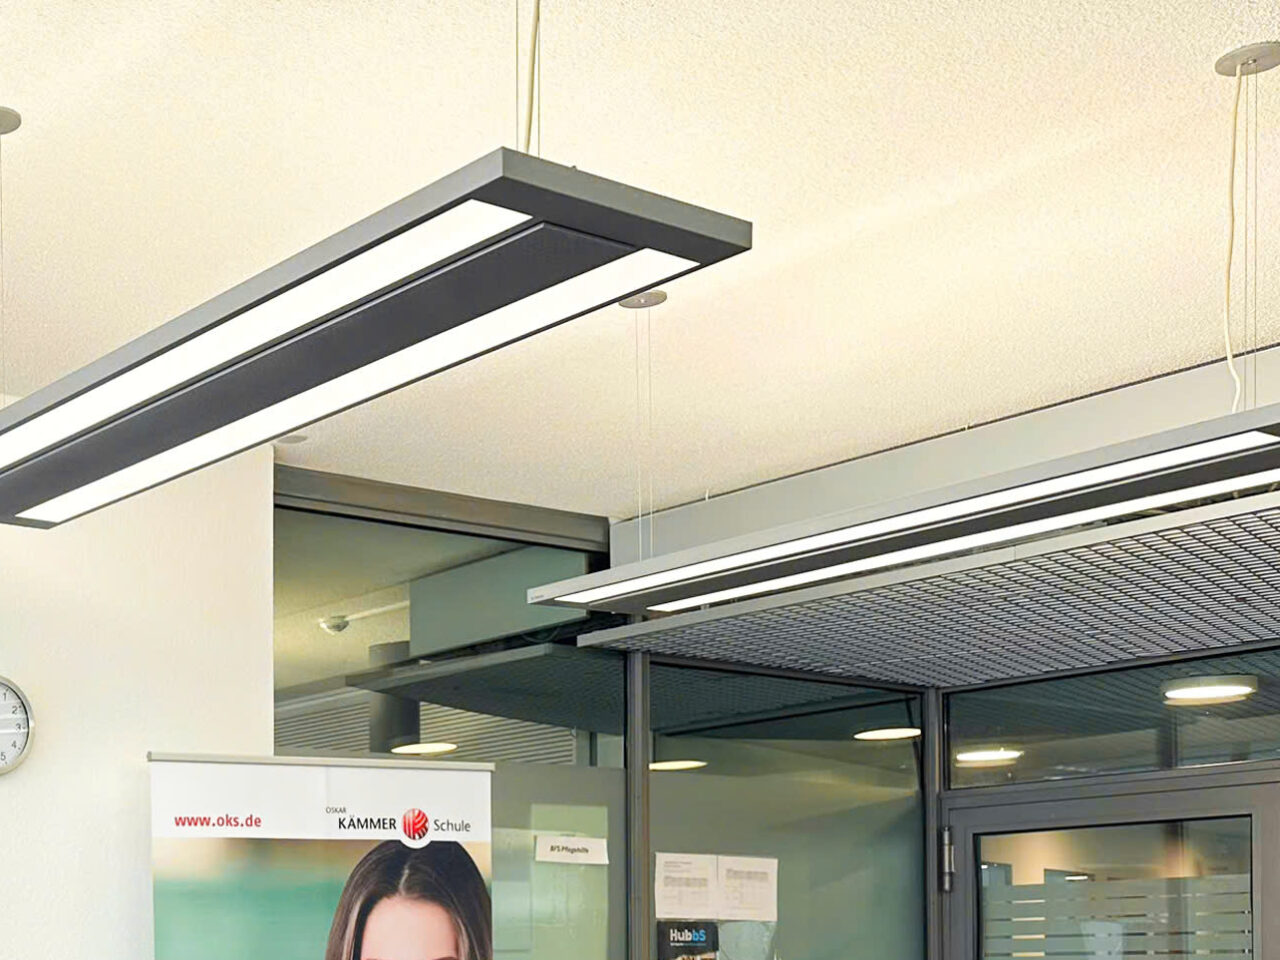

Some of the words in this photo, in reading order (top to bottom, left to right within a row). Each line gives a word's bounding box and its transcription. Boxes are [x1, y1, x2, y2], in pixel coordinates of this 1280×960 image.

[325, 806, 347, 815] OSKAR
[174, 814, 262, 828] www.oks.de
[338, 815, 397, 831] KÄMMER
[433, 820, 471, 833] Schule
[670, 928, 707, 942] HubbS
